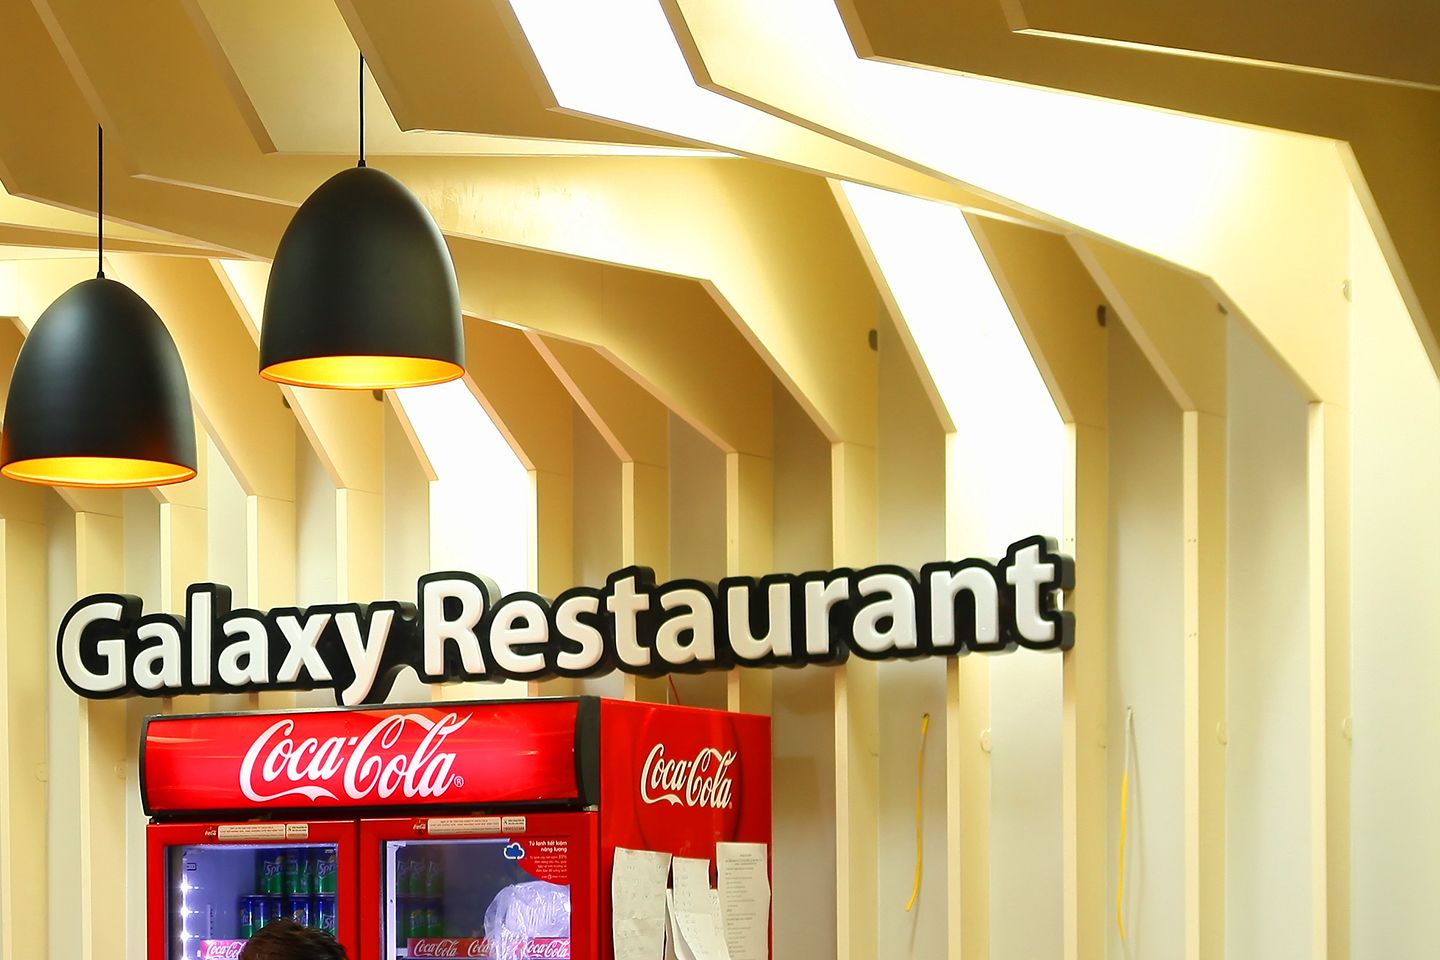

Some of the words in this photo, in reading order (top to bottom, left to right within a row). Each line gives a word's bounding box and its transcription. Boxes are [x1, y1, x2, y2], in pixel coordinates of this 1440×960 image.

[59, 586, 395, 706] Galaxy
[421, 541, 1066, 684] Restaurant
[239, 712, 474, 802] Coca-Cola
[640, 743, 737, 808] Coca-Cola
[414, 939, 459, 957] Coca-Cola
